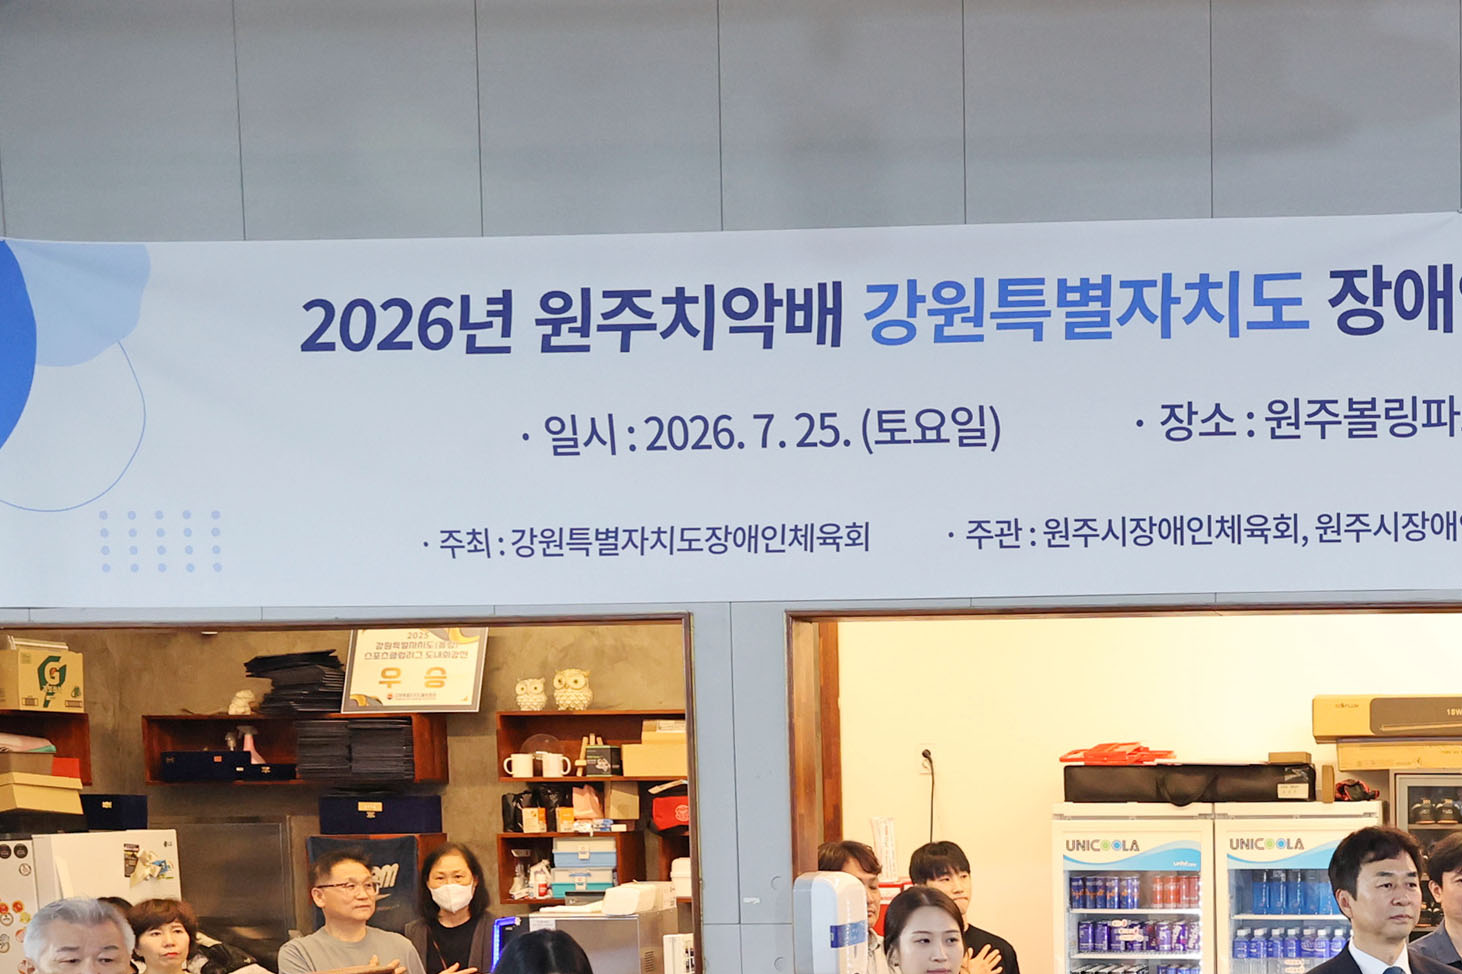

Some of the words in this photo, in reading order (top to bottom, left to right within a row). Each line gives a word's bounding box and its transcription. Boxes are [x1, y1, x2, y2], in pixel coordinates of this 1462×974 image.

[299, 288, 513, 355] 2026년
[534, 280, 843, 354] 원주치악배
[863, 270, 1311, 347] 강원특별자치도
[544, 412, 617, 457] 일시
[644, 414, 745, 452] 2026.
[752, 413, 787, 449] 7.
[794, 412, 851, 448] 25.
[861, 404, 1001, 456] (토요일)
[1160, 400, 1237, 443] 장소
[439, 527, 491, 560] 주최
[511, 521, 870, 558] 강원특별자치도장애인체육회
[965, 517, 1023, 551] 주관
[1042, 512, 1309, 549] 원주시장애인체육회,
[407, 631, 429, 640] 2025
[1065, 839, 1141, 852] UNICOOLA
[1229, 838, 1305, 850] UNICOOLA
